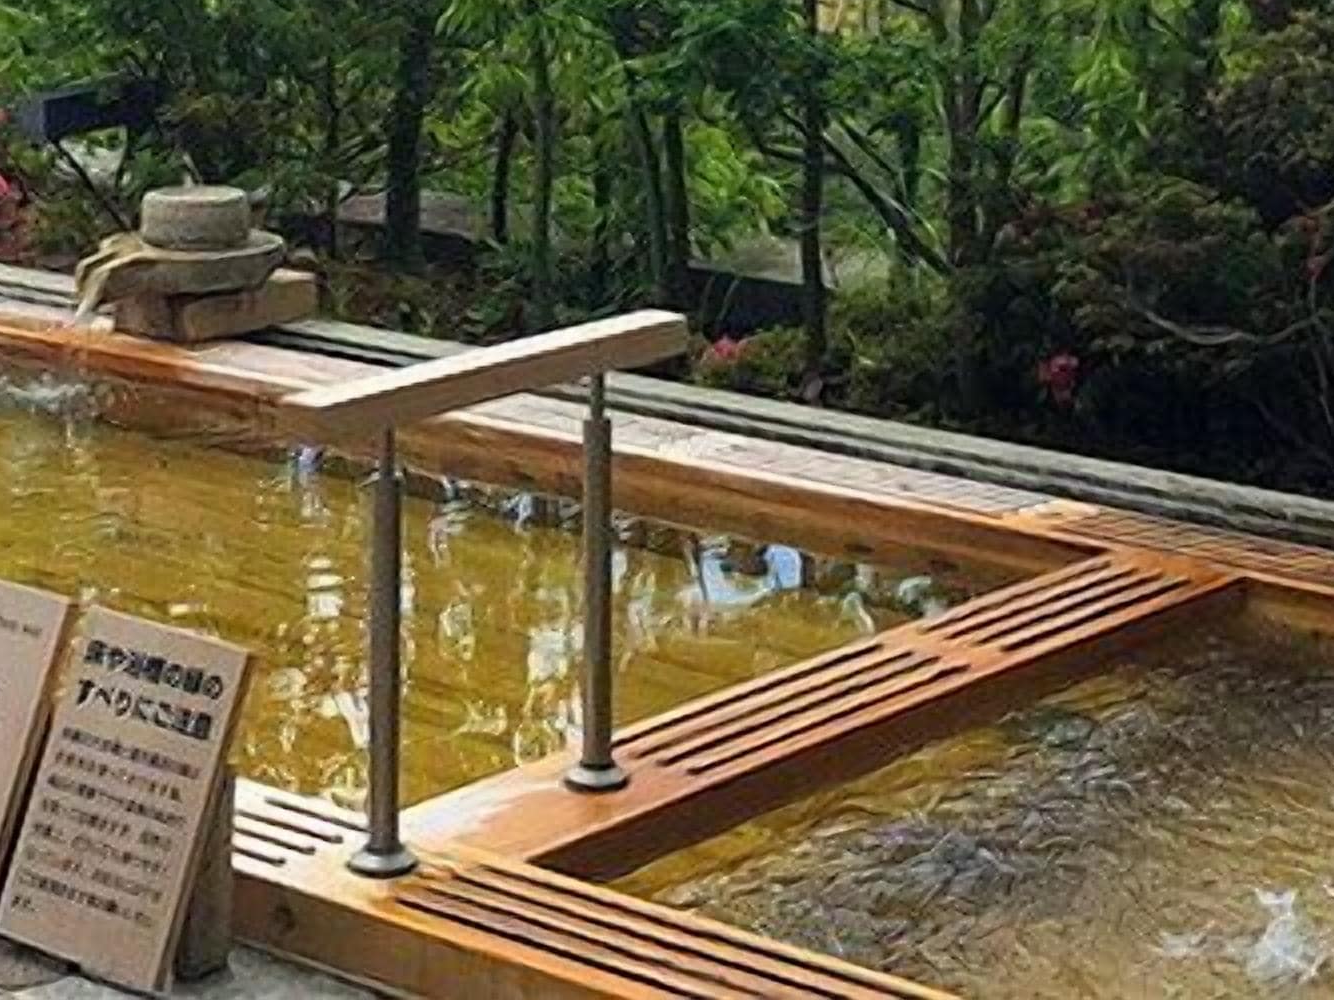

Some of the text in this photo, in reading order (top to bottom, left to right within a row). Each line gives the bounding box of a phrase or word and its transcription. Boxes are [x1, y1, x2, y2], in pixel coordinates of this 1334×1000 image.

[77, 679, 213, 741] すべりにご注意
